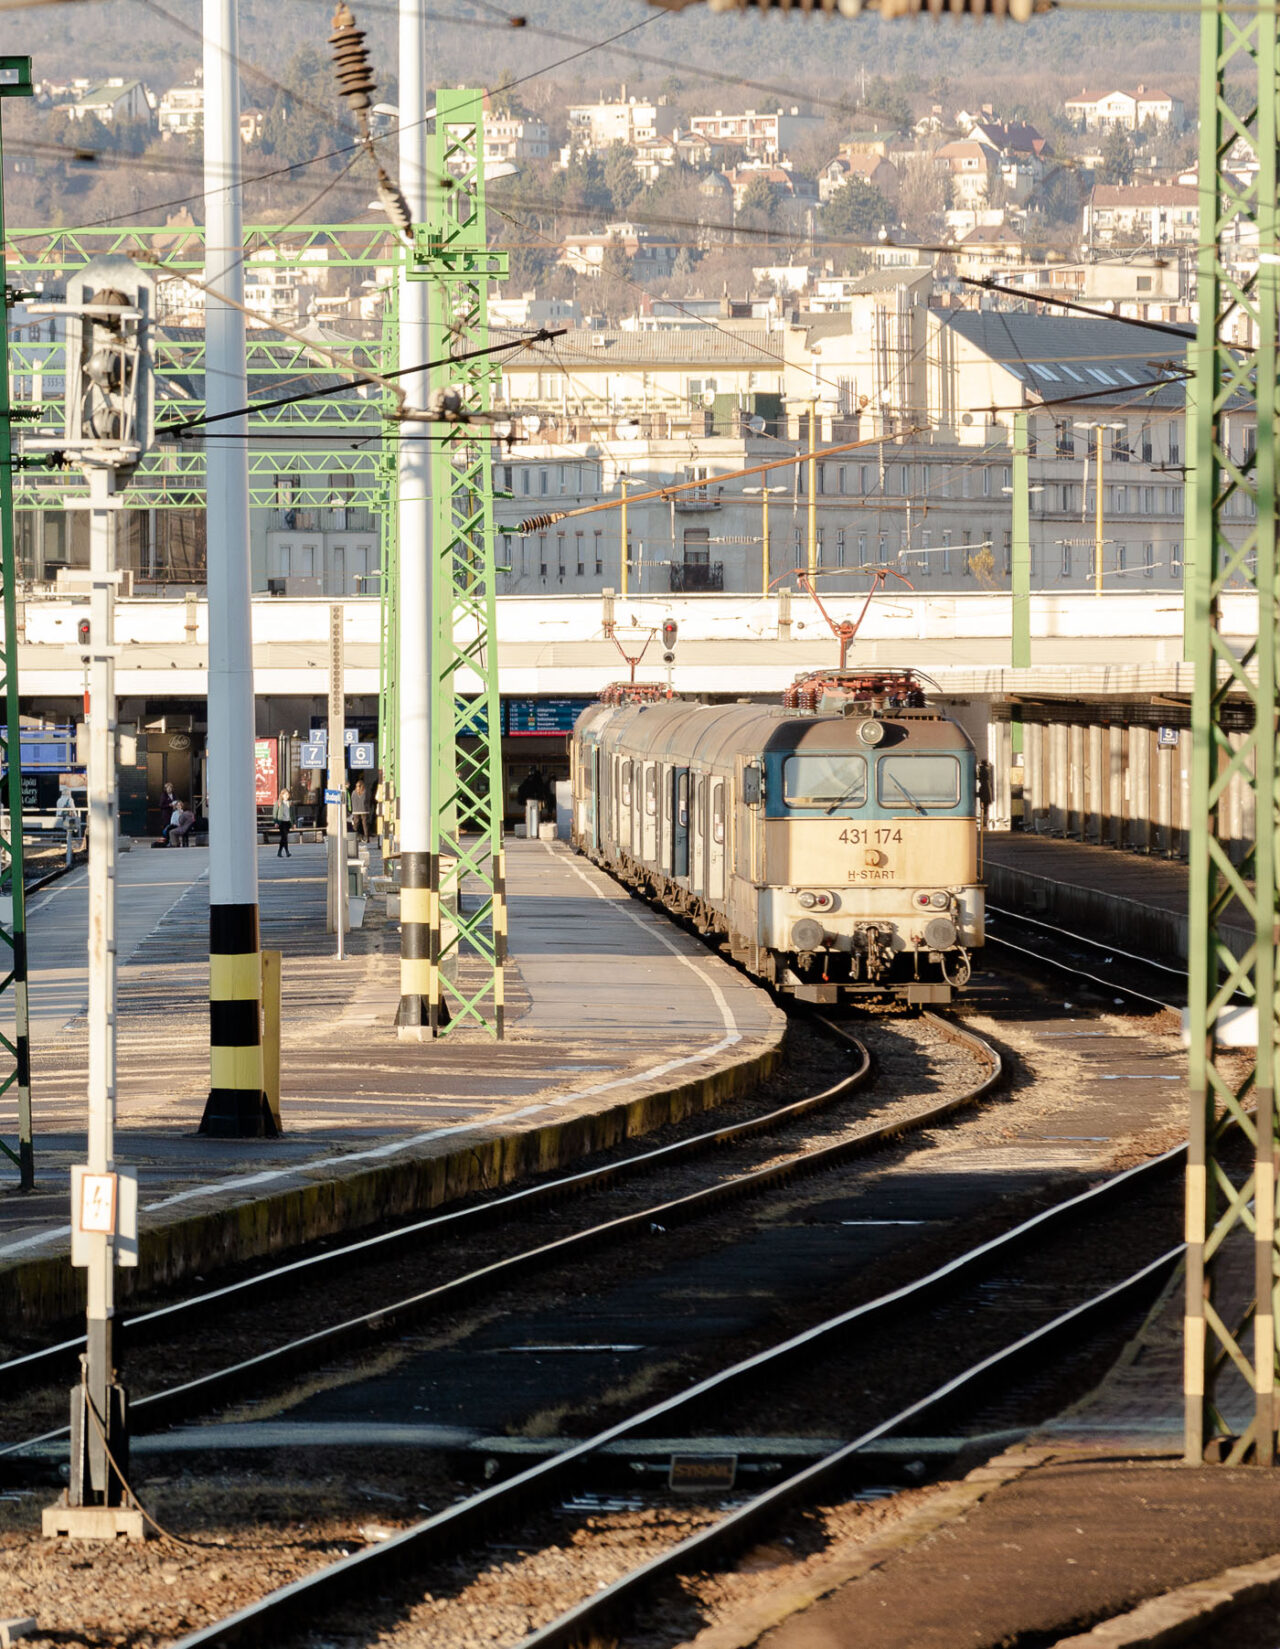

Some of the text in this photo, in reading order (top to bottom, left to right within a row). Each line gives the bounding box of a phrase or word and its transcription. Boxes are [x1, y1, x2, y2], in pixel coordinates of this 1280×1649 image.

[314, 732, 322, 741] 7
[346, 731, 353, 740] 6
[1165, 728, 1173, 738] 5
[309, 747, 319, 760] 7
[355, 747, 366, 760] 6
[838, 828, 903, 844] 431 174
[848, 870, 896, 881] H-START
